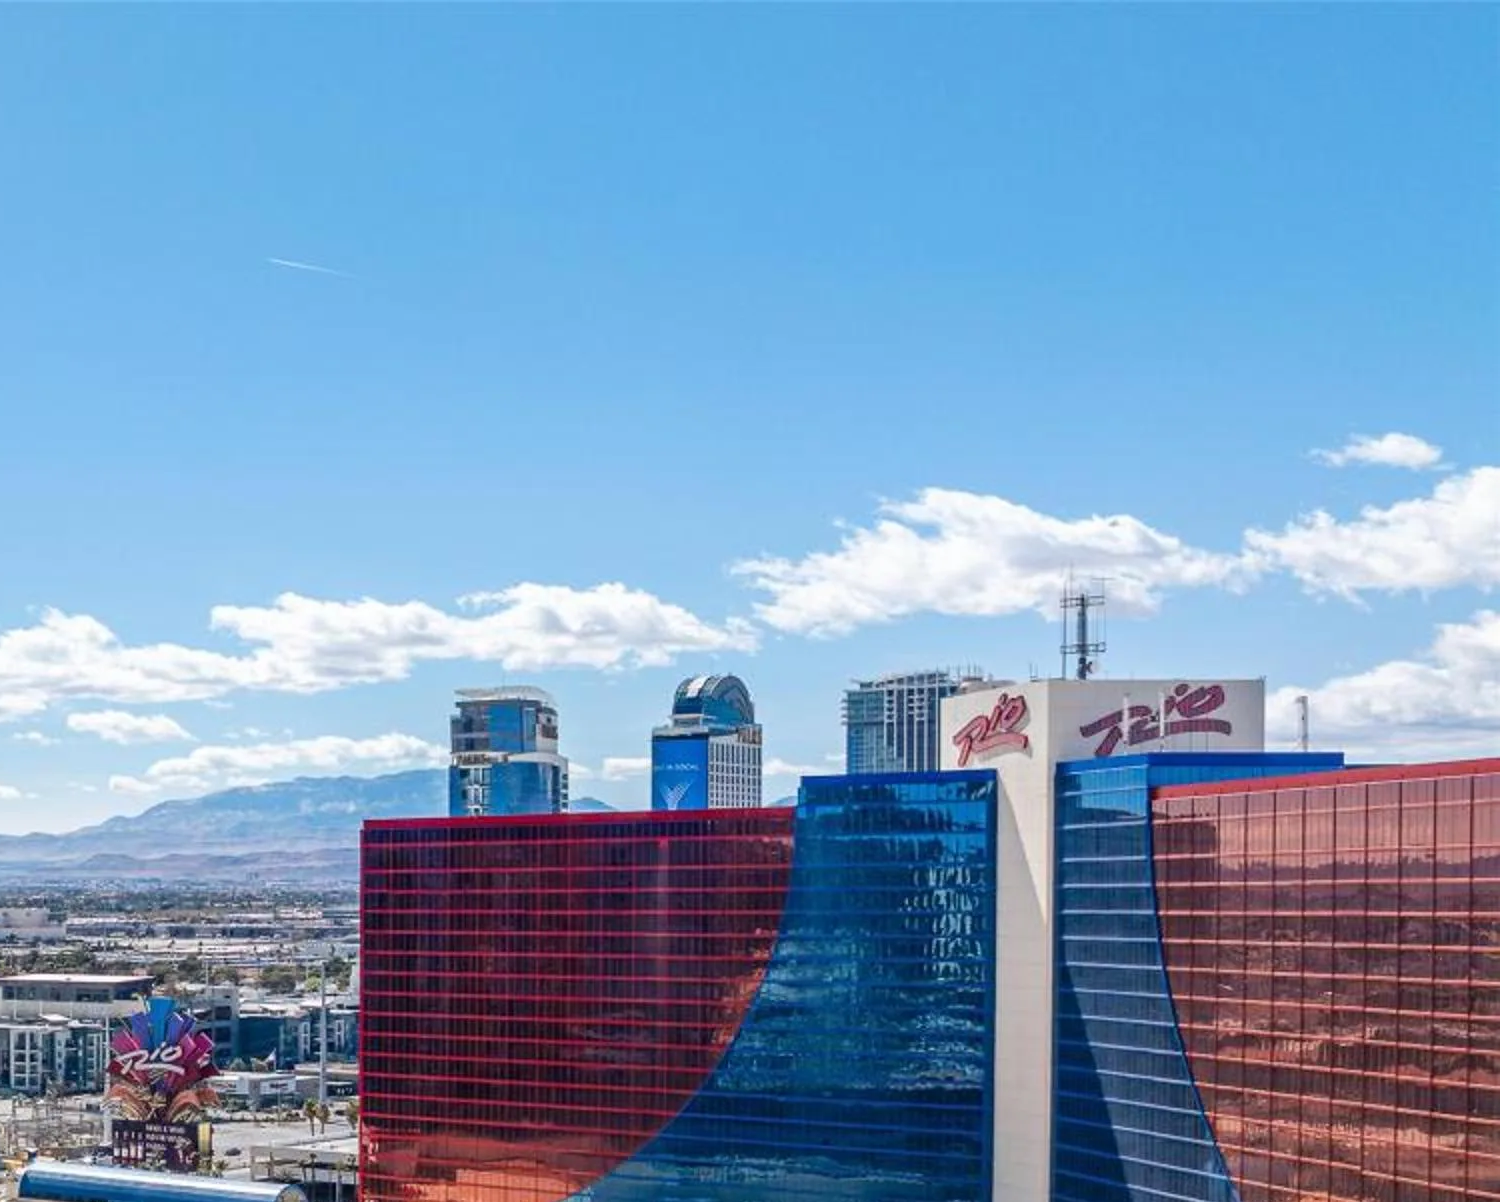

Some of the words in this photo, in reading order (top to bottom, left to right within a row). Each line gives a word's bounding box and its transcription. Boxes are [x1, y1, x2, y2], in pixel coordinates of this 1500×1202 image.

[953, 693, 1028, 767] Rio
[1079, 683, 1232, 757] Rio
[116, 1041, 185, 1075] Rio
